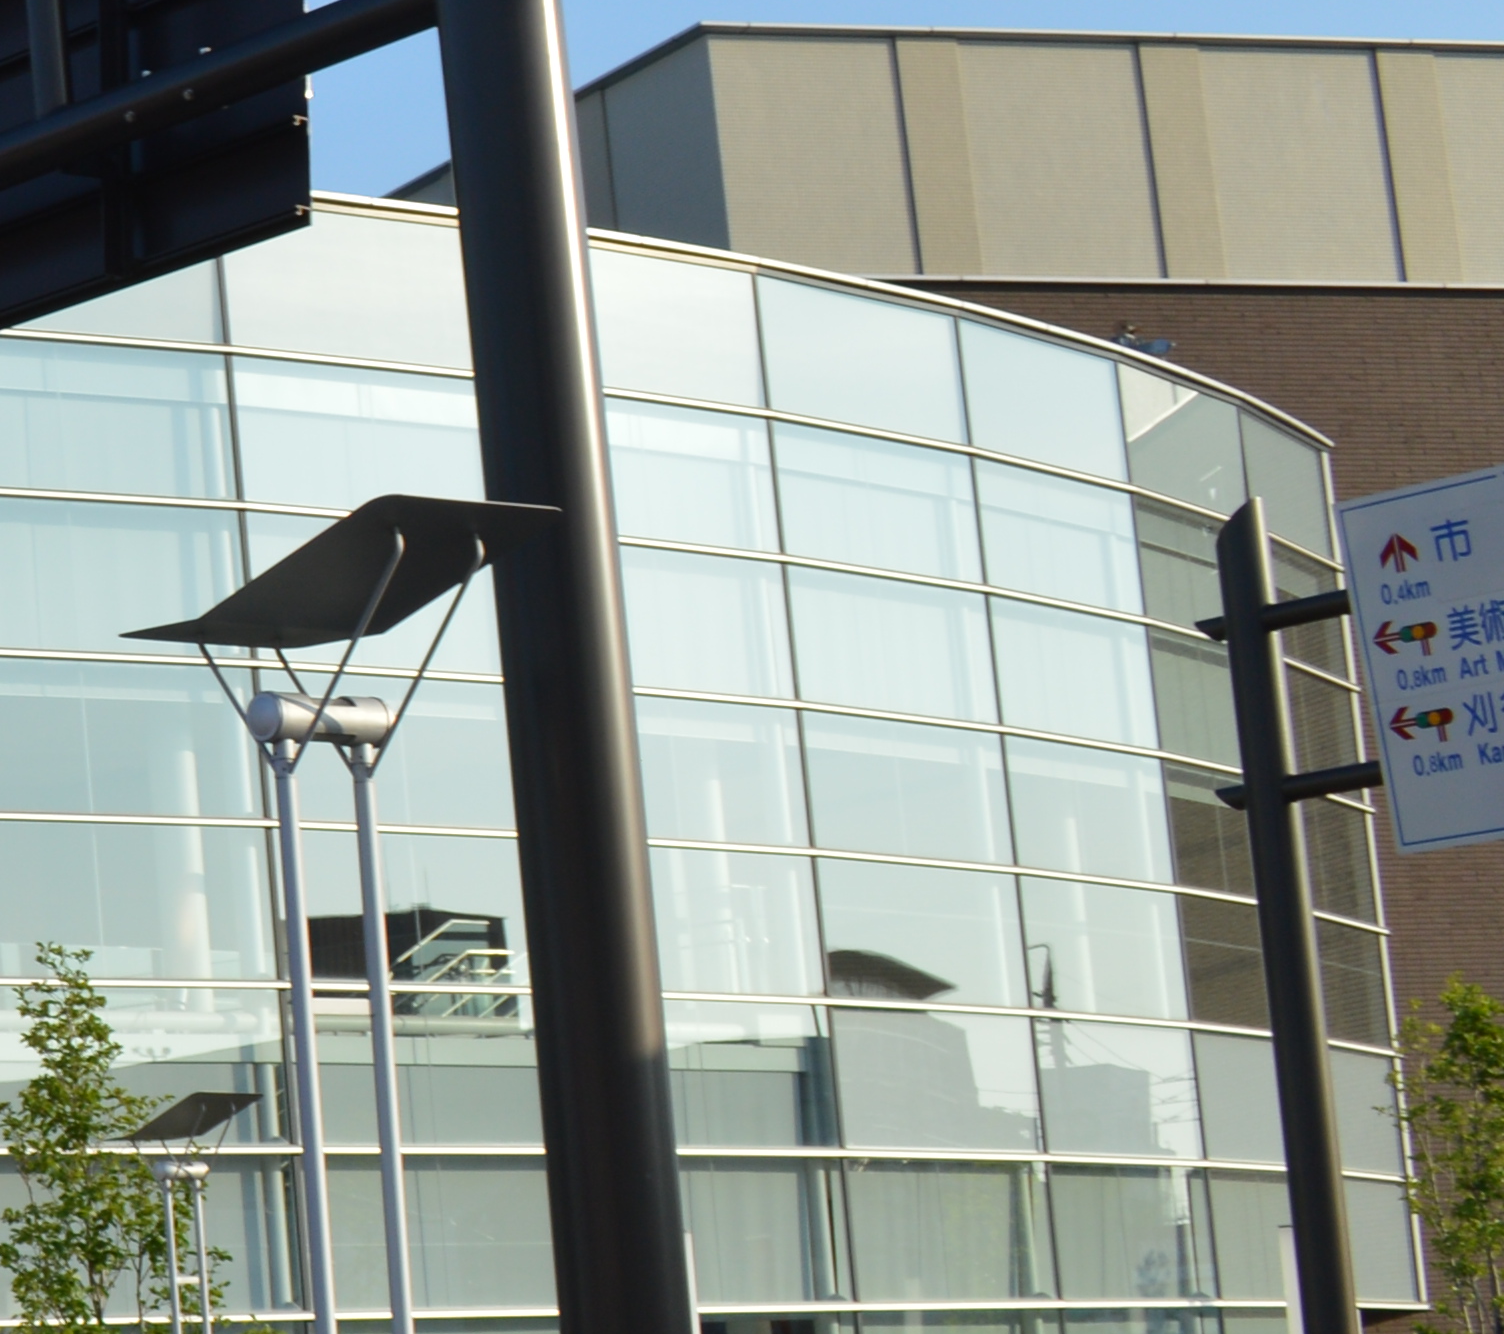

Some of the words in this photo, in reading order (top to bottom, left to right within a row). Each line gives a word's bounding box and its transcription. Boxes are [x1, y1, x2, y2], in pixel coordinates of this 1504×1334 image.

[1429, 519, 1473, 562] 市
[1380, 579, 1432, 605] 0.4km
[1396, 665, 1448, 691] 0.8km
[1459, 654, 1490, 679] Art
[1462, 691, 1504, 737] 刈
[1412, 751, 1465, 778] 0.8km
[1477, 742, 1504, 766] Ka
